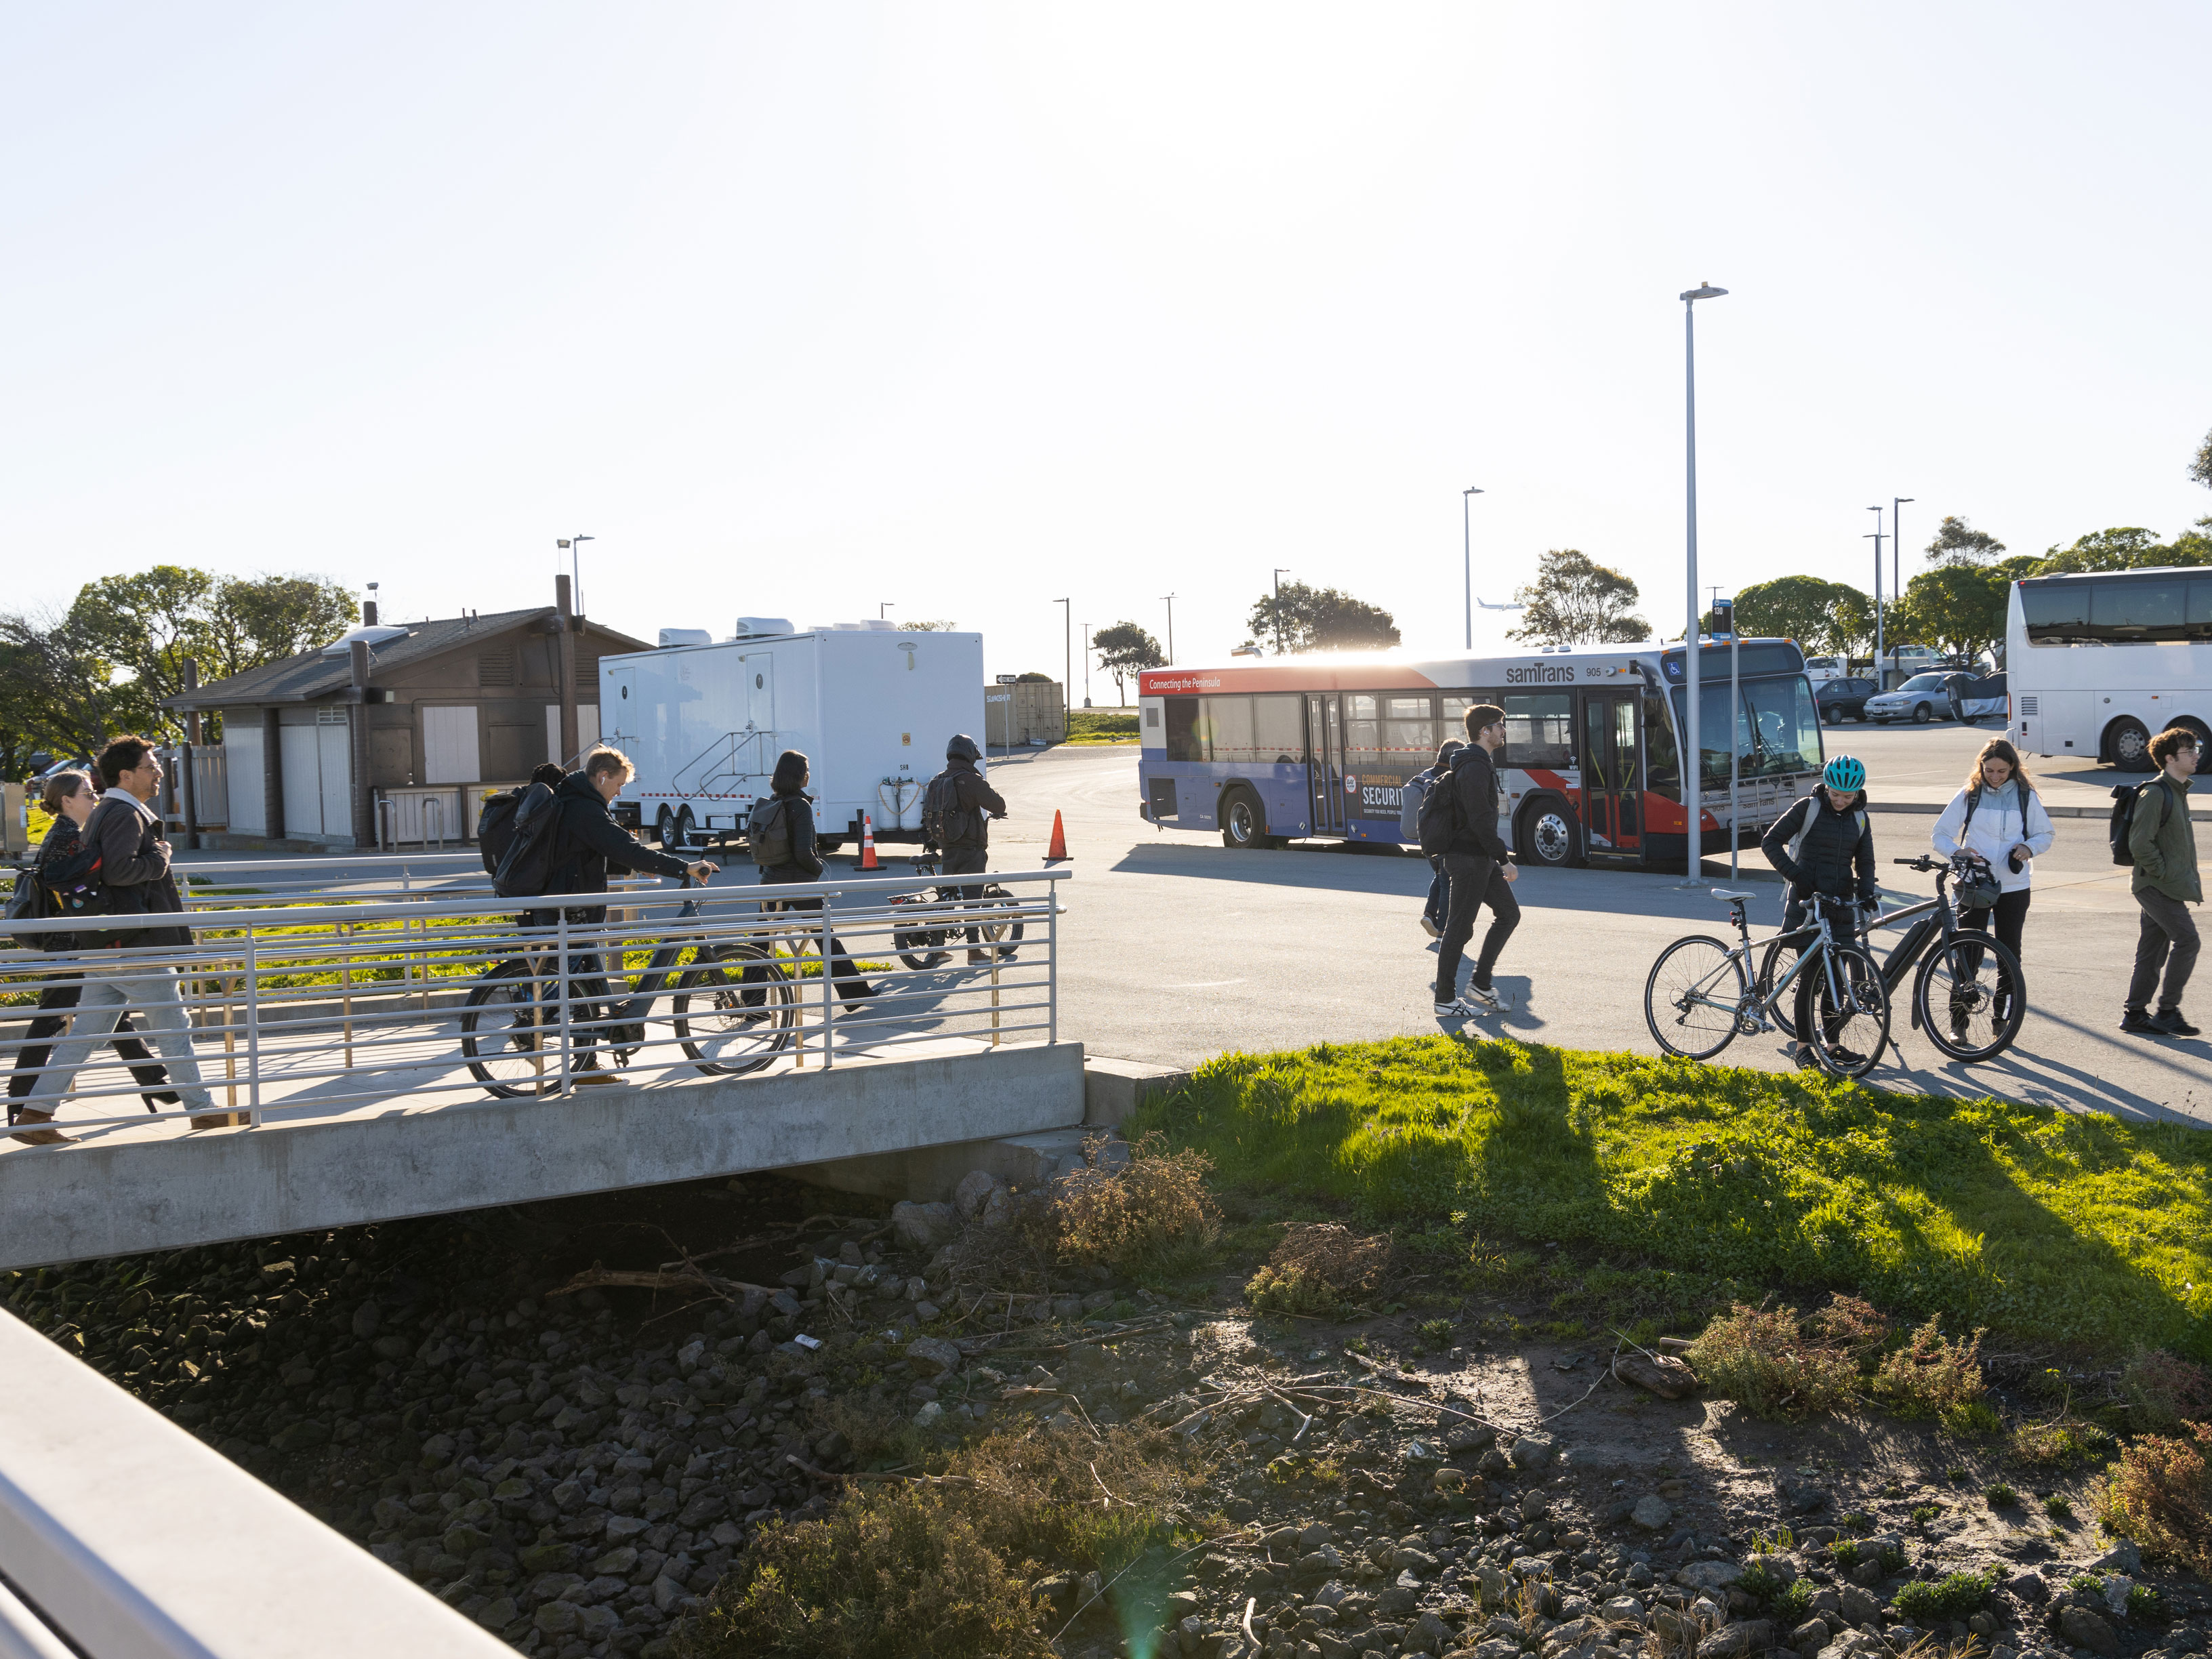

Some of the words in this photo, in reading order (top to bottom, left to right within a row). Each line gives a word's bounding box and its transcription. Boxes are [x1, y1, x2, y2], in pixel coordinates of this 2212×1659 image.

[1714, 607, 1723, 615] 130
[1506, 662, 1574, 683] samTrans
[1586, 668, 1601, 677] 905
[1149, 678, 1181, 691] Connecting
[1182, 677, 1191, 688] the
[1192, 676, 1220, 688] Peninsula
[1361, 774, 1403, 787] COMMERCIAL
[1362, 786, 1404, 806] SECURIT
